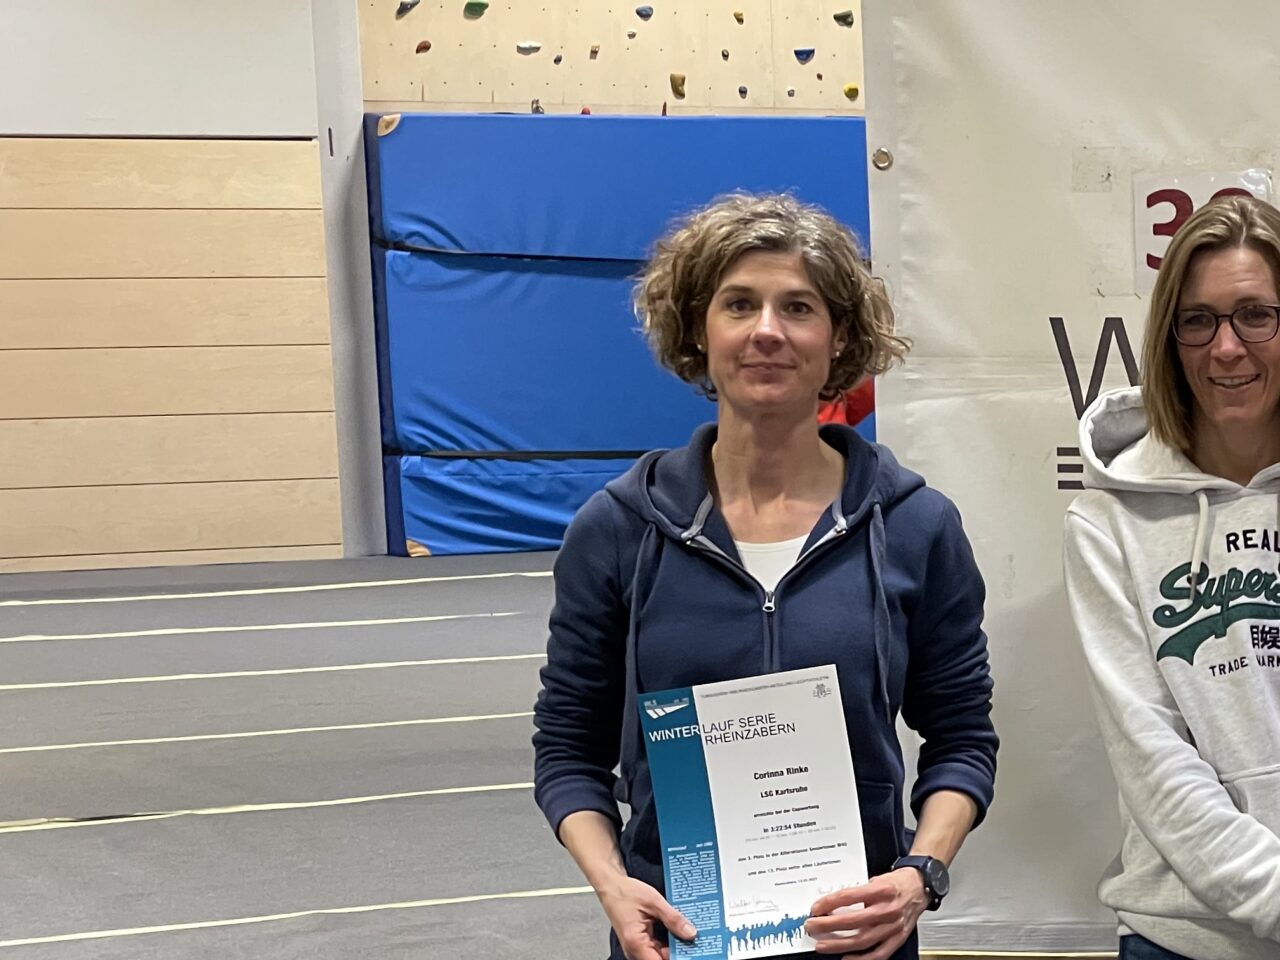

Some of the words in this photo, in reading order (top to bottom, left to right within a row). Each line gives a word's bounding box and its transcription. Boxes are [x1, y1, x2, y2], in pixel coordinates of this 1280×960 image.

[1209, 656, 1249, 677] TRADE
[648, 724, 700, 742] WINTER
[702, 719, 735, 734] LAUF
[738, 712, 777, 729] SERIE
[705, 722, 796, 746] RHEINZABERN
[753, 769, 784, 780] Corinna
[786, 765, 809, 775] Rinke
